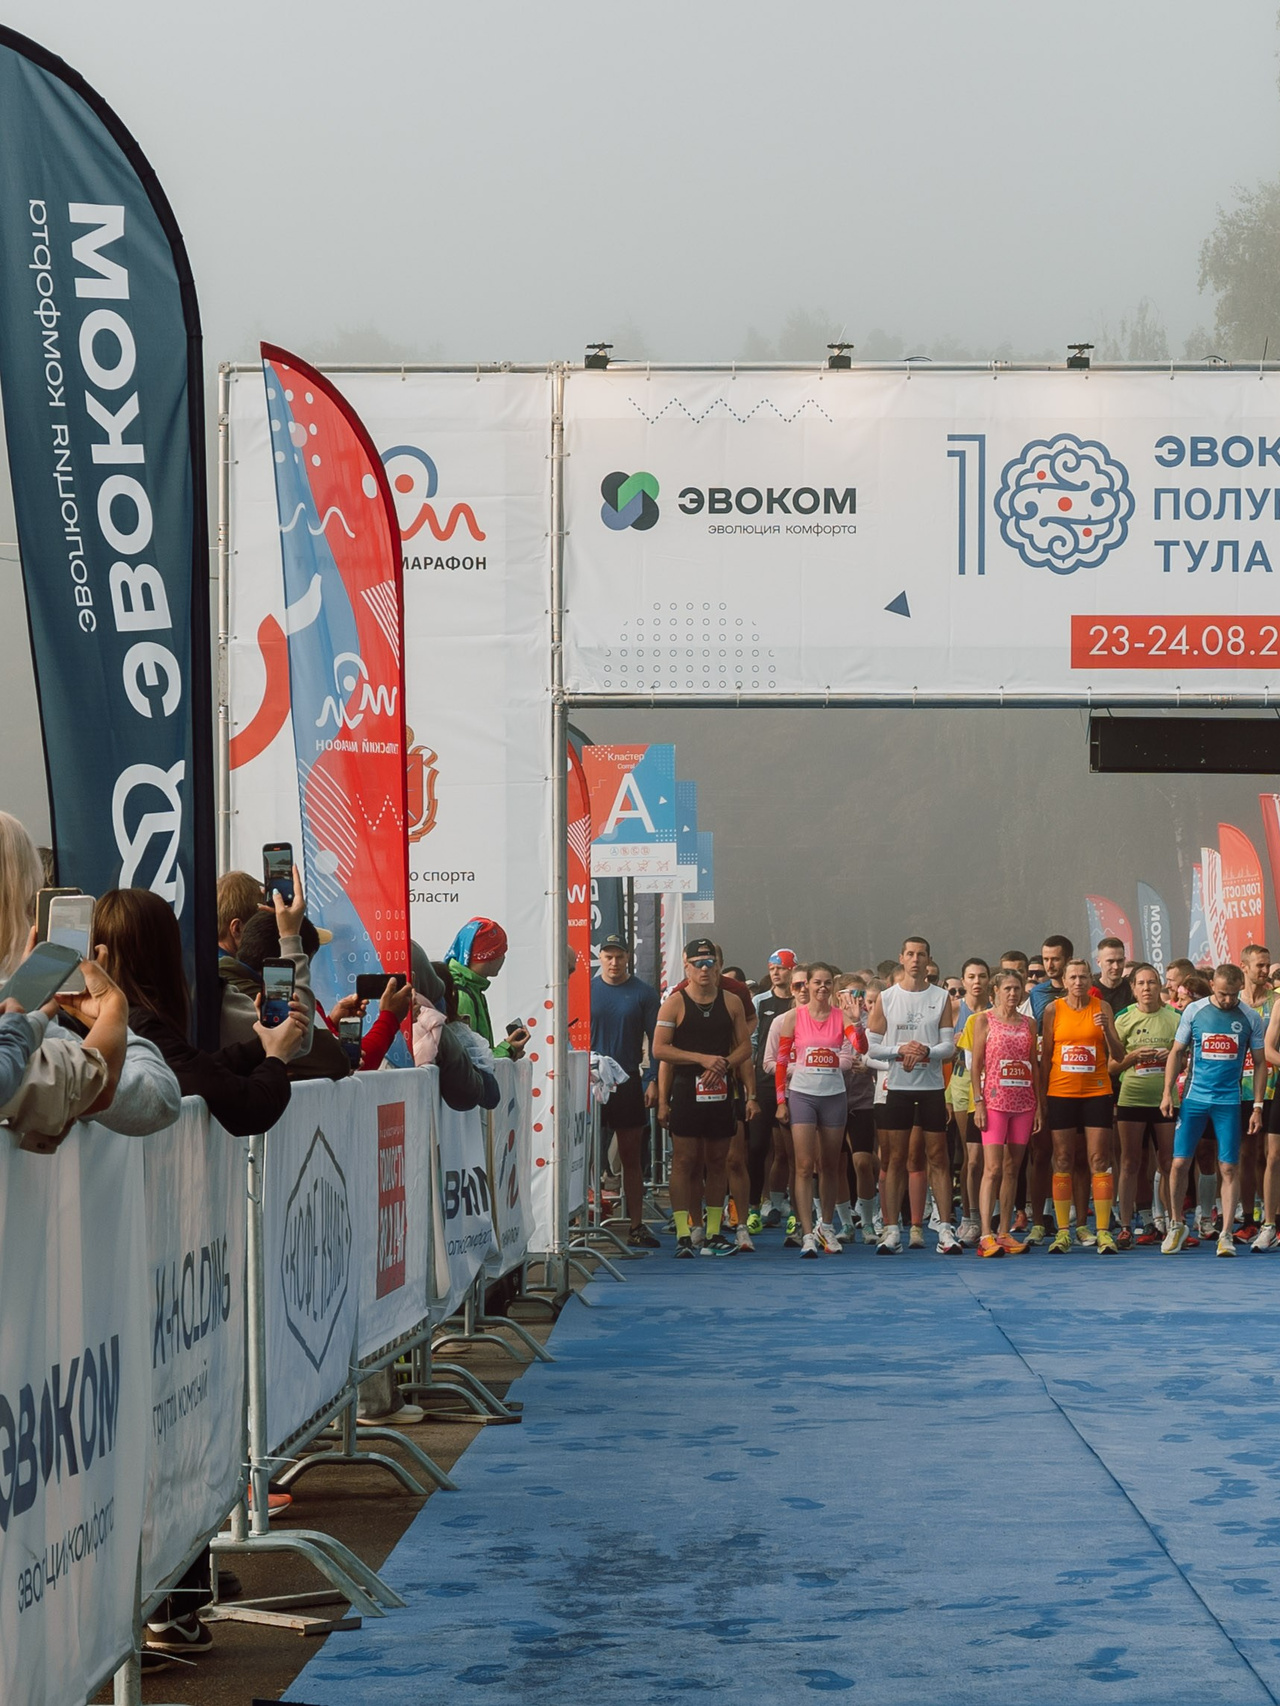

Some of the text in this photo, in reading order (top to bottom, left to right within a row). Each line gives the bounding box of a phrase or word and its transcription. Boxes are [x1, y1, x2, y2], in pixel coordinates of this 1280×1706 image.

[678, 486, 857, 516] ЭВОКОМ
[707, 522, 857, 538] эволюция комфорта
[1154, 539, 1273, 574] ТУЛА
[607, 752, 645, 763] Кластер
[422, 871, 476, 887] спорта
[408, 889, 459, 903] бласти
[1209, 1041, 1231, 1050] 2003
[812, 1054, 834, 1064] 2008
[1069, 1053, 1089, 1063] 2263
[1008, 1067, 1025, 1076] 2314
